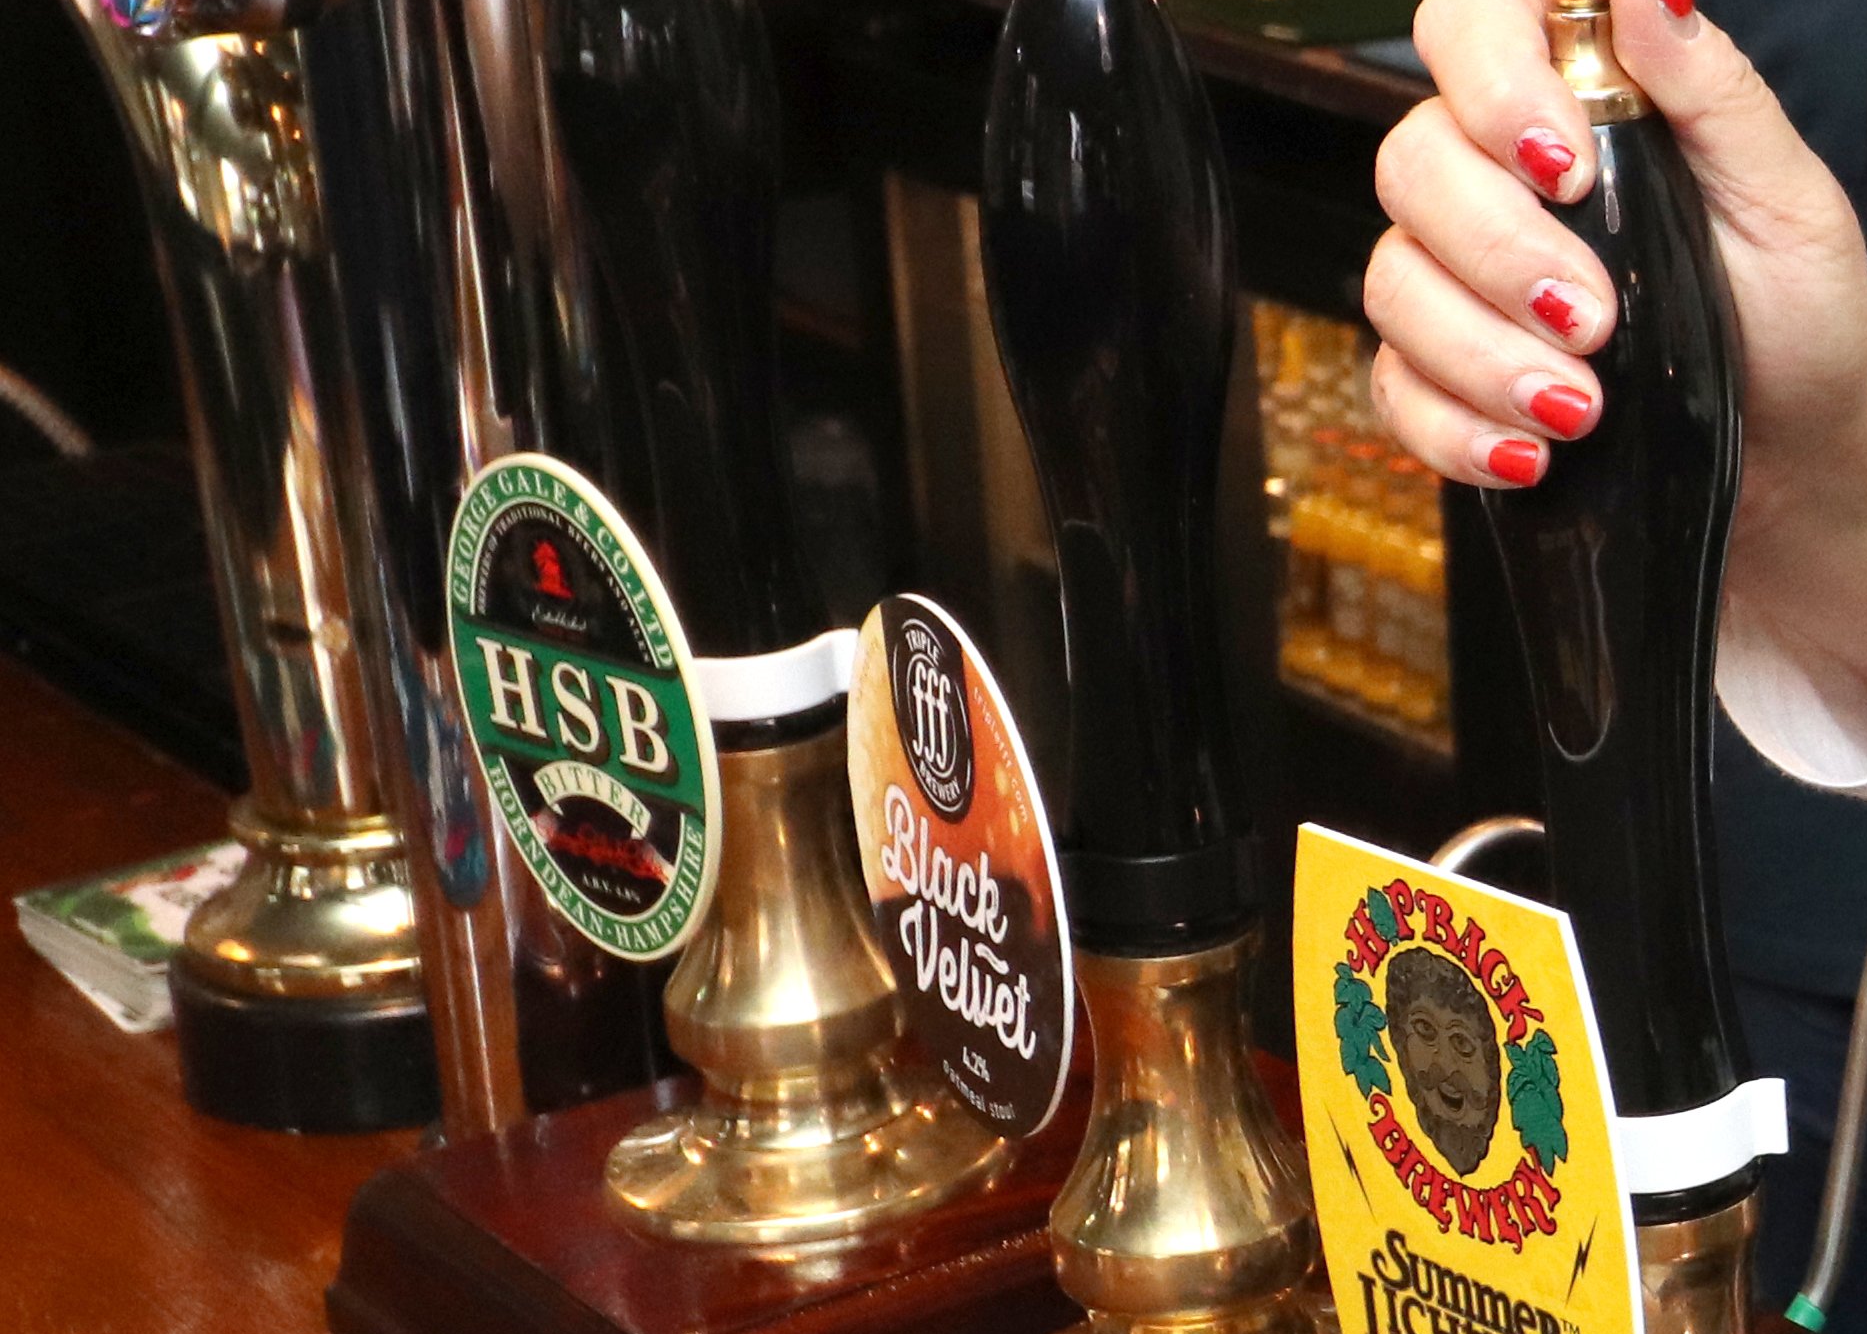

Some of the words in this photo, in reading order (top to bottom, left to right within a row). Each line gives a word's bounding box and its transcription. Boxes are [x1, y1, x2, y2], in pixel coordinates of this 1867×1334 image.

[452, 485, 498, 605] GEORGE
[497, 468, 568, 508] GALE
[574, 503, 591, 528] &
[495, 507, 562, 537] TRADITIONAL
[476, 636, 671, 775] HSB
[905, 628, 940, 666] TRIPLE
[912, 661, 951, 770] fff
[539, 766, 644, 821] BITTER
[919, 760, 961, 802] BREWERY
[614, 825, 703, 951] HAMPSHIRE
[882, 784, 1008, 945] Black
[898, 900, 1036, 1061] Velvet
[1414, 888, 1545, 1045] BACK
[943, 1059, 986, 1119] oatmeal
[987, 1099, 1016, 1122] stout
[1368, 1092, 1561, 1255] BREWERY
